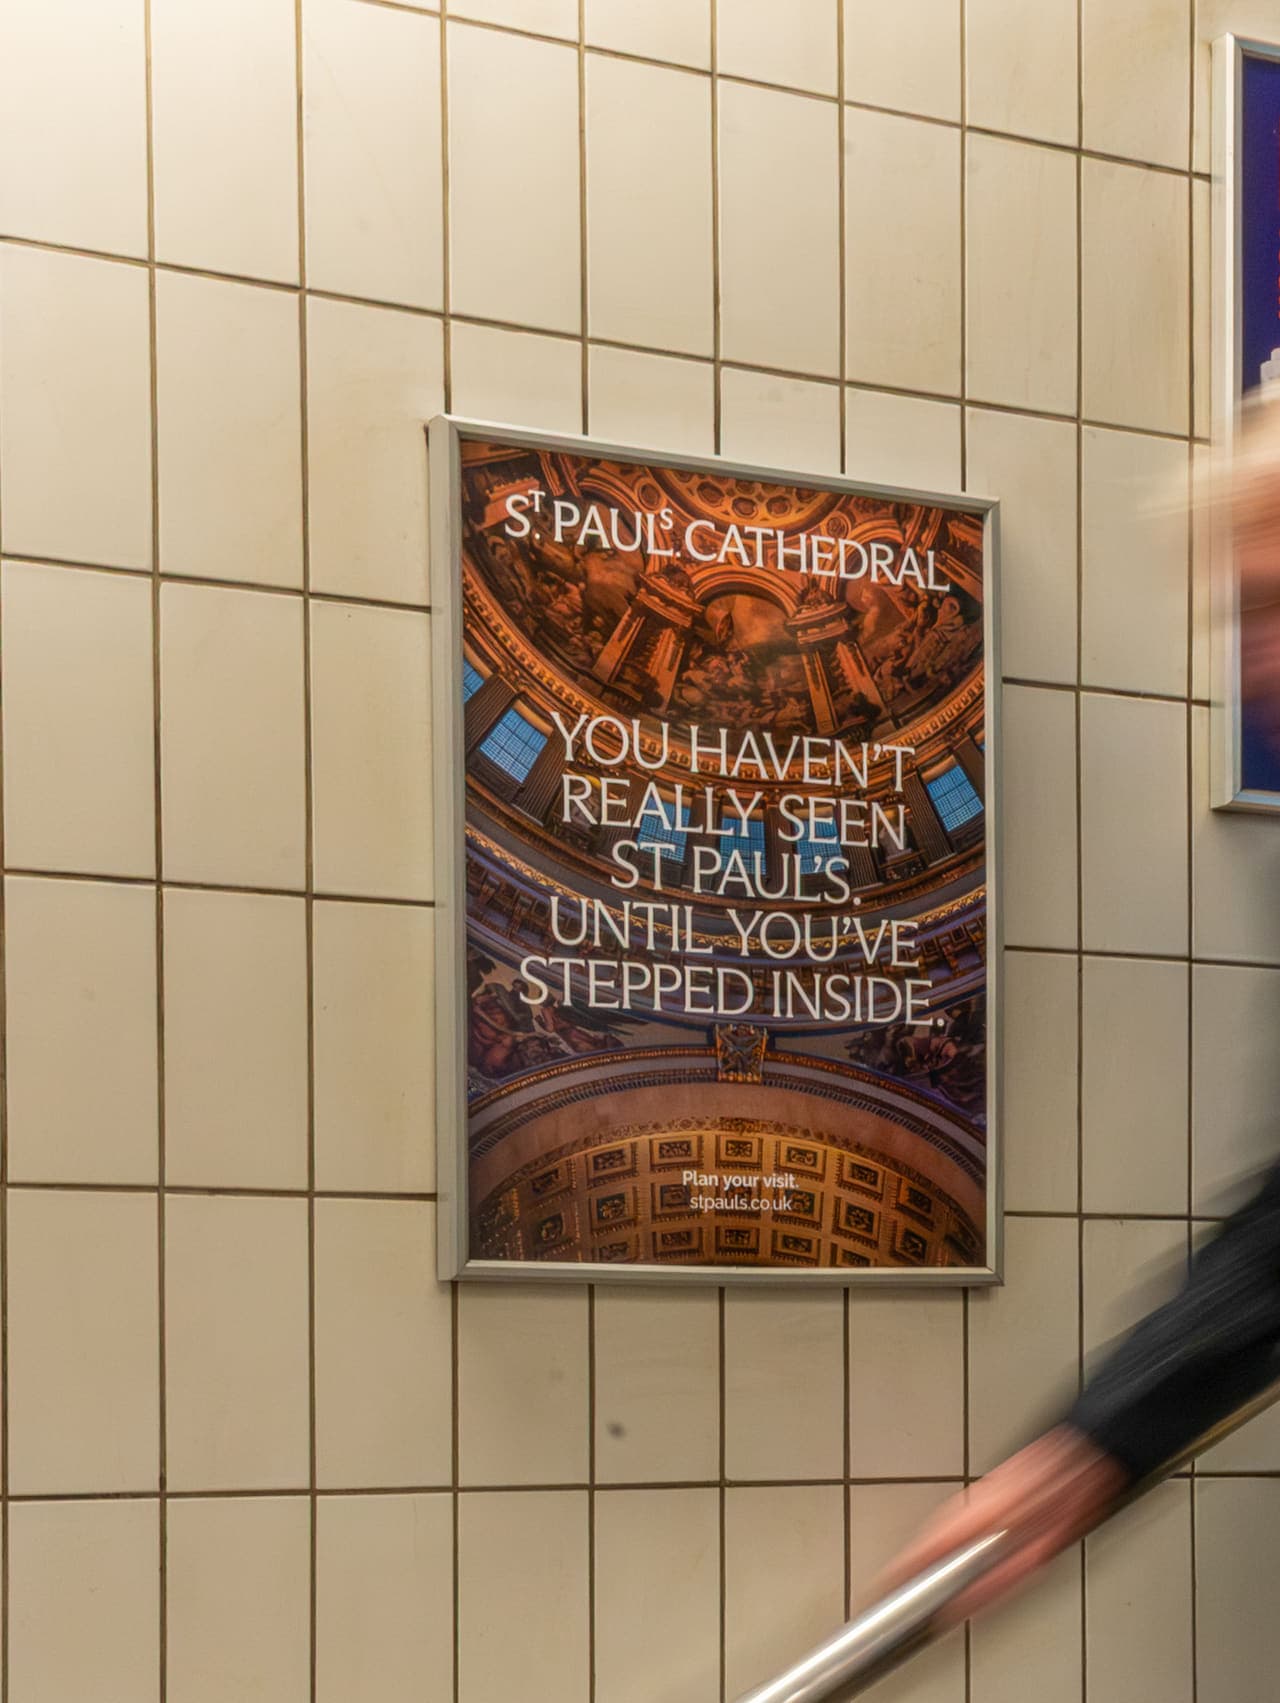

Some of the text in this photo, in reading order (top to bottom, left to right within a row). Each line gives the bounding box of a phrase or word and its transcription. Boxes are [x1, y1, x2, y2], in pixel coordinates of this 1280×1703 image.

[685, 519, 950, 592] CATHEDRAL
[550, 711, 915, 791] YOU HAVEN'T
[561, 773, 905, 850] REALLY SEEN
[610, 840, 861, 905] ST PAUL'S.
[550, 896, 919, 967] UNTIL YOU'VE
[519, 956, 945, 1027] STEPPED INSIDE.
[682, 1169, 799, 1191] Plan your visit.
[690, 1194, 792, 1213] stpauls.co.uk
